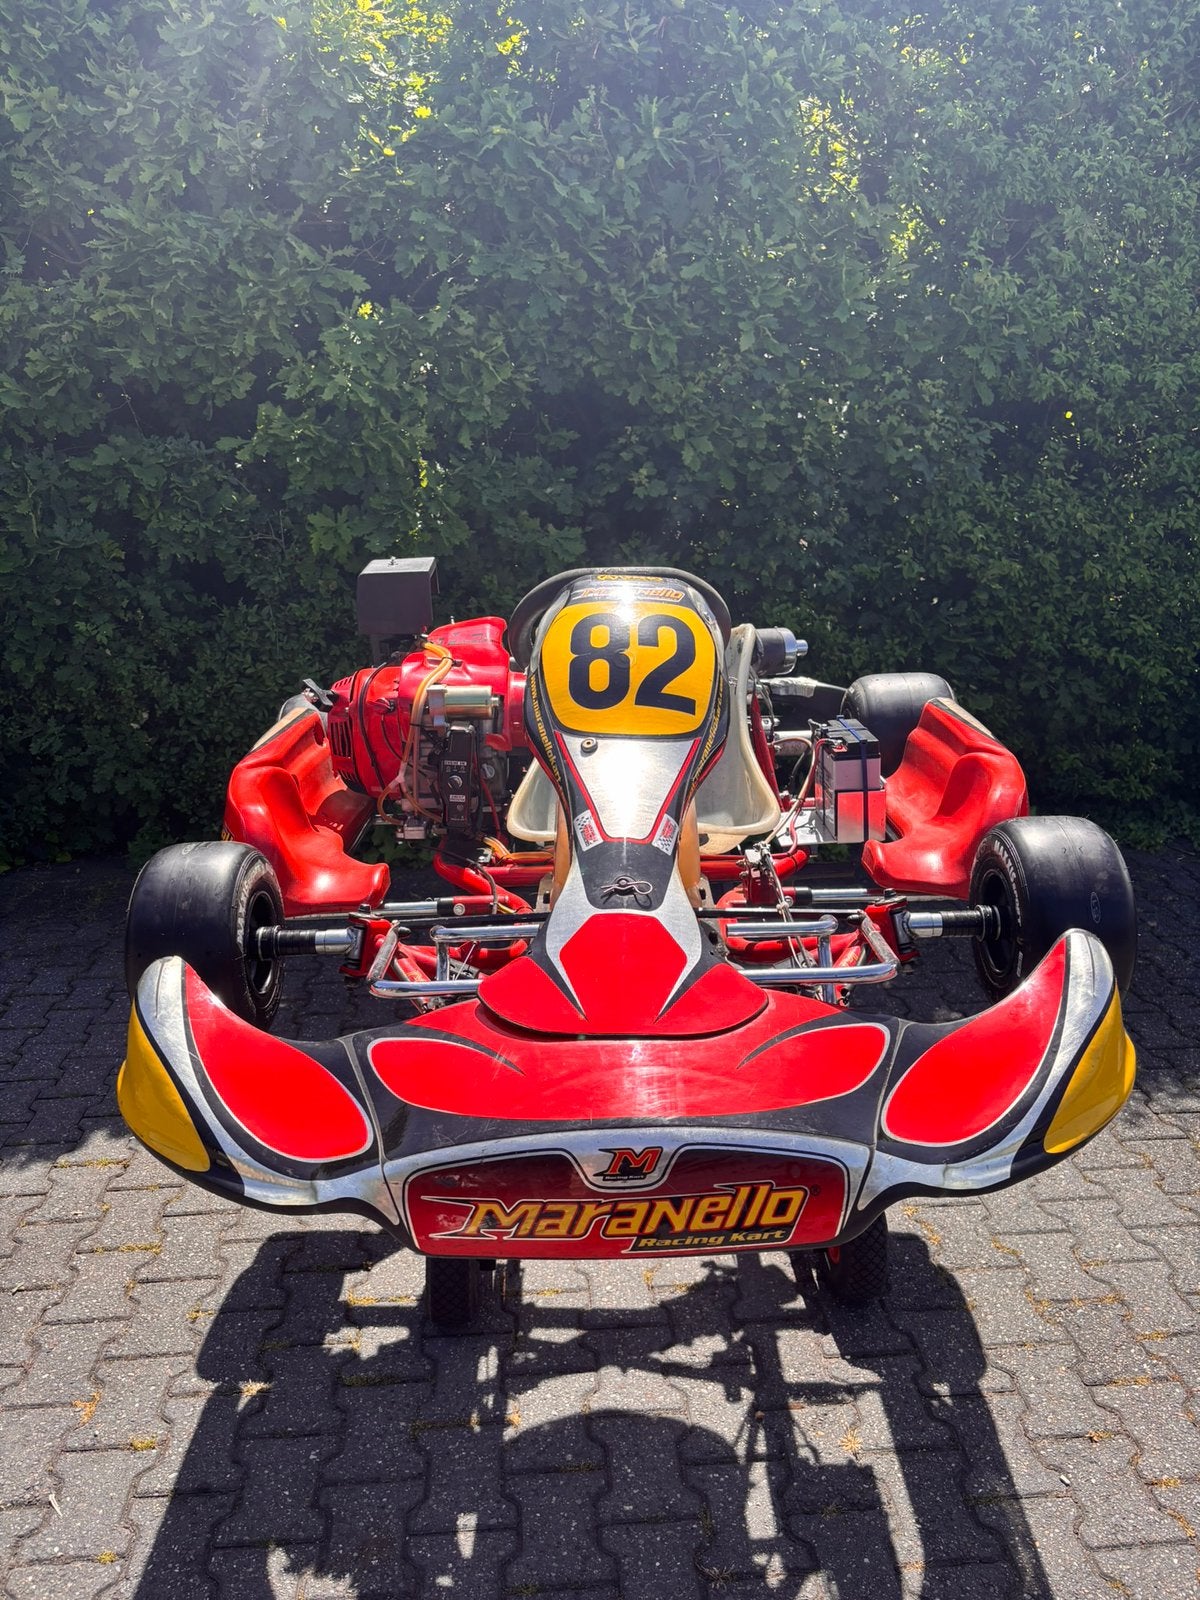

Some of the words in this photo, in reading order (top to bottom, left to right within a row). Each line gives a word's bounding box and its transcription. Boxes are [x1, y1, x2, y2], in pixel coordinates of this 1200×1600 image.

[569, 612, 697, 716] 82
[607, 1148, 661, 1175] M
[637, 1235, 725, 1247] Racing
[729, 1229, 787, 1242] Kart
